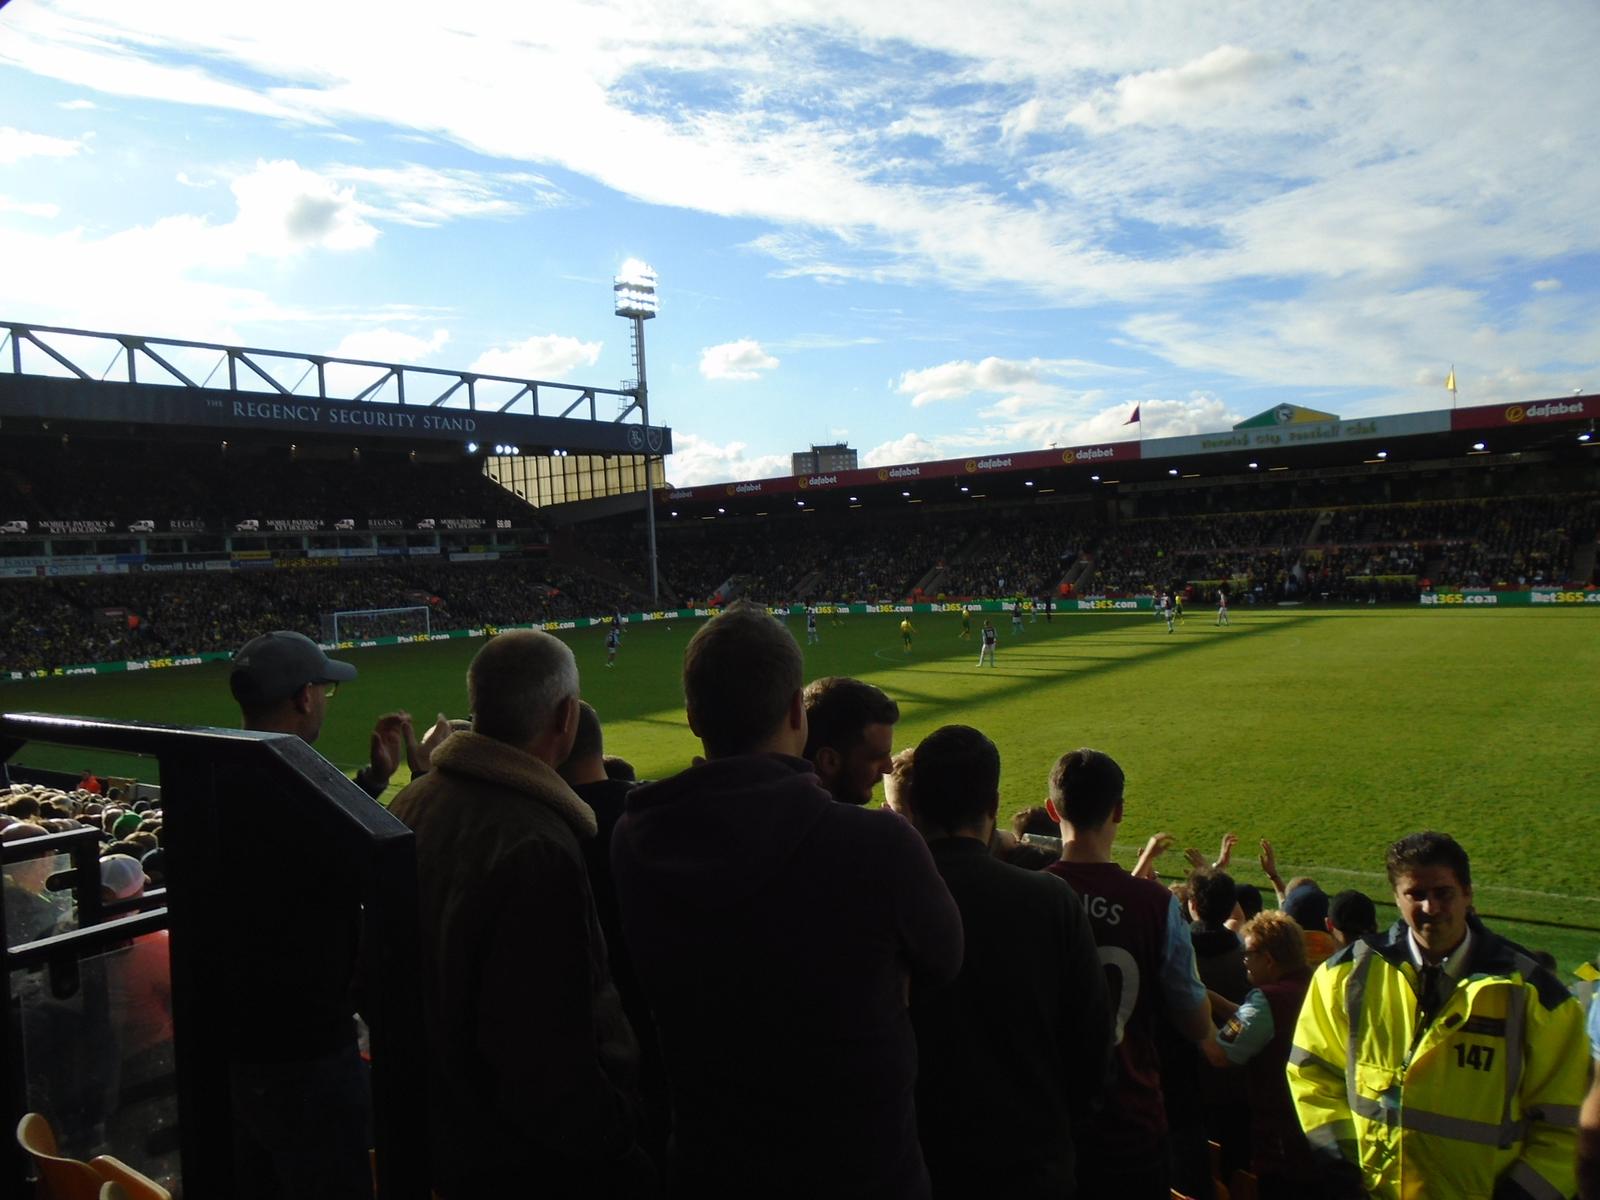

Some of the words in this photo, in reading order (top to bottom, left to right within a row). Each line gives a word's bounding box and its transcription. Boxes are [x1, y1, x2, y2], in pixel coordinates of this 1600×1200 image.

[206, 399, 224, 407] THE
[232, 400, 321, 422] REGENCY
[329, 408, 417, 428] SECURITY
[423, 415, 477, 432] STAND
[1526, 402, 1585, 417] dafabet
[1075, 447, 1114, 461] dafabet
[977, 457, 1013, 470] dafabet
[888, 467, 921, 479] dafabet
[808, 475, 838, 487] dafabet
[735, 483, 762, 495] dafabet
[1453, 1042, 1497, 1072] 147
